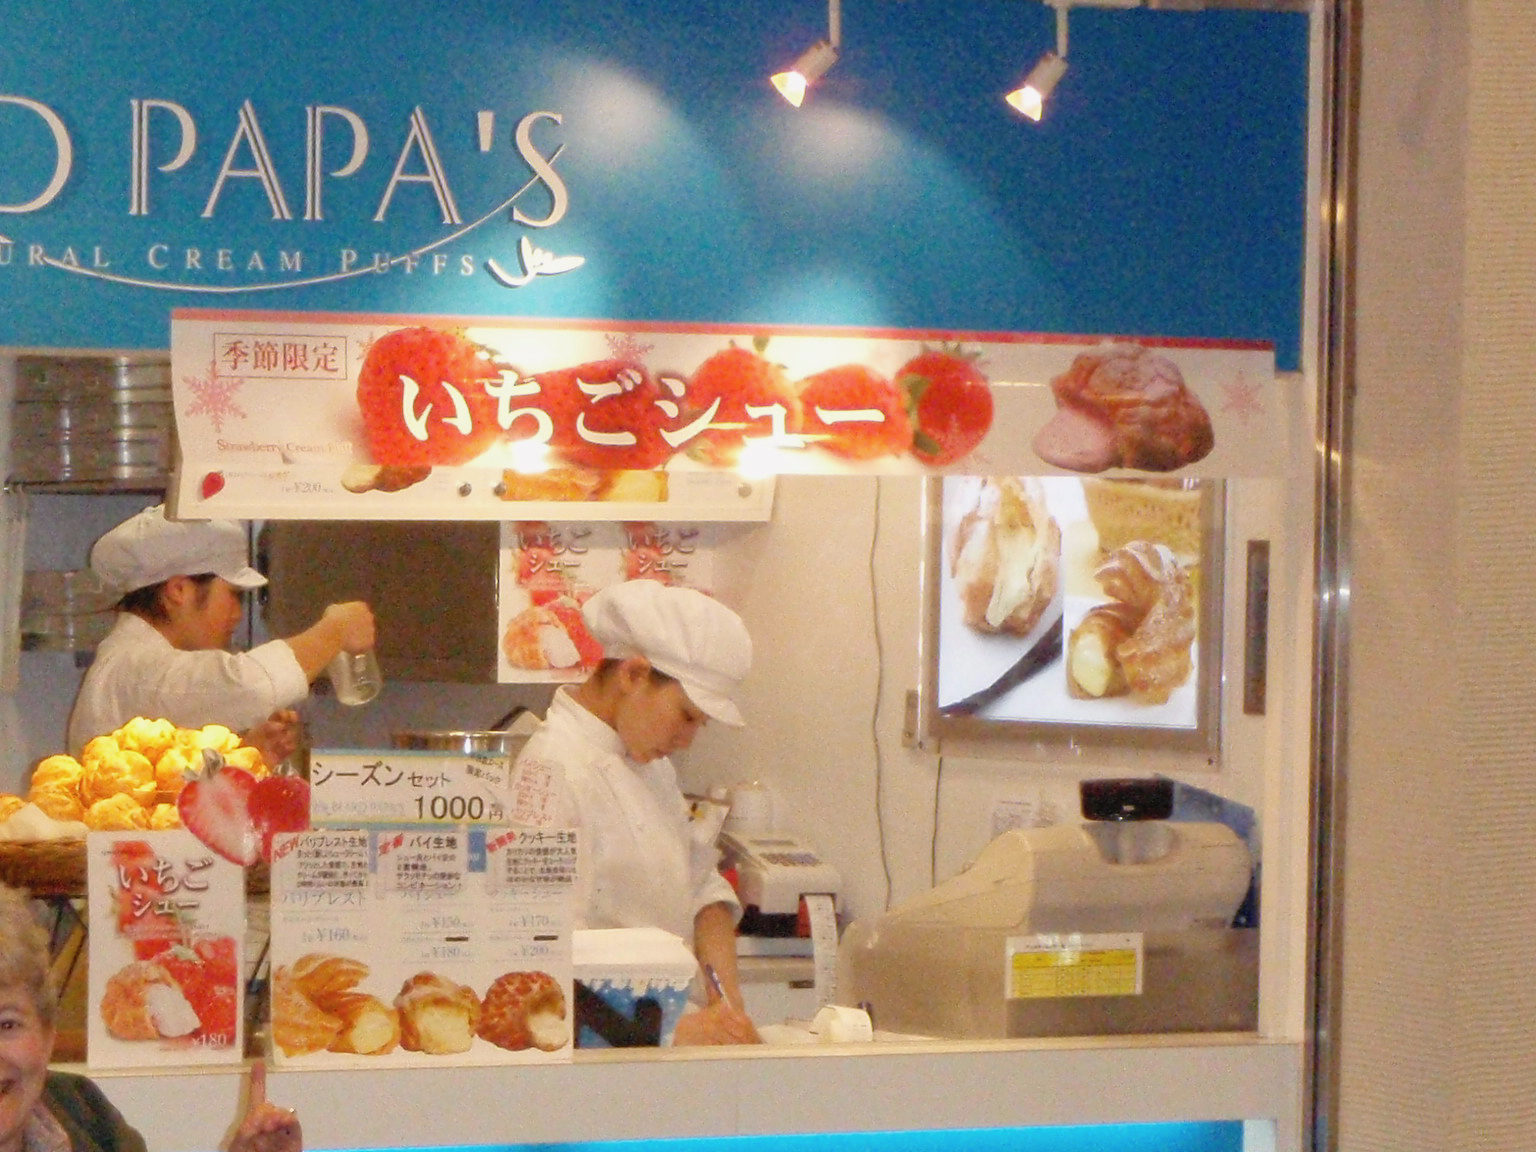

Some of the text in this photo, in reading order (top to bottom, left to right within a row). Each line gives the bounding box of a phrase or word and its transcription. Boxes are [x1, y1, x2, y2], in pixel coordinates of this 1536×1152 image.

[130, 97, 568, 229] PAPA'S
[148, 244, 304, 273] CREAM
[341, 249, 475, 277] PUFFS
[221, 340, 340, 373] 季節限定
[399, 368, 886, 450] いちごシュー
[216, 438, 282, 453] Strawberry
[529, 554, 581, 574] シュー
[638, 554, 689, 574] シュー
[270, 833, 300, 863] NEW
[119, 857, 214, 896] いちご
[132, 893, 200, 918] シュー
